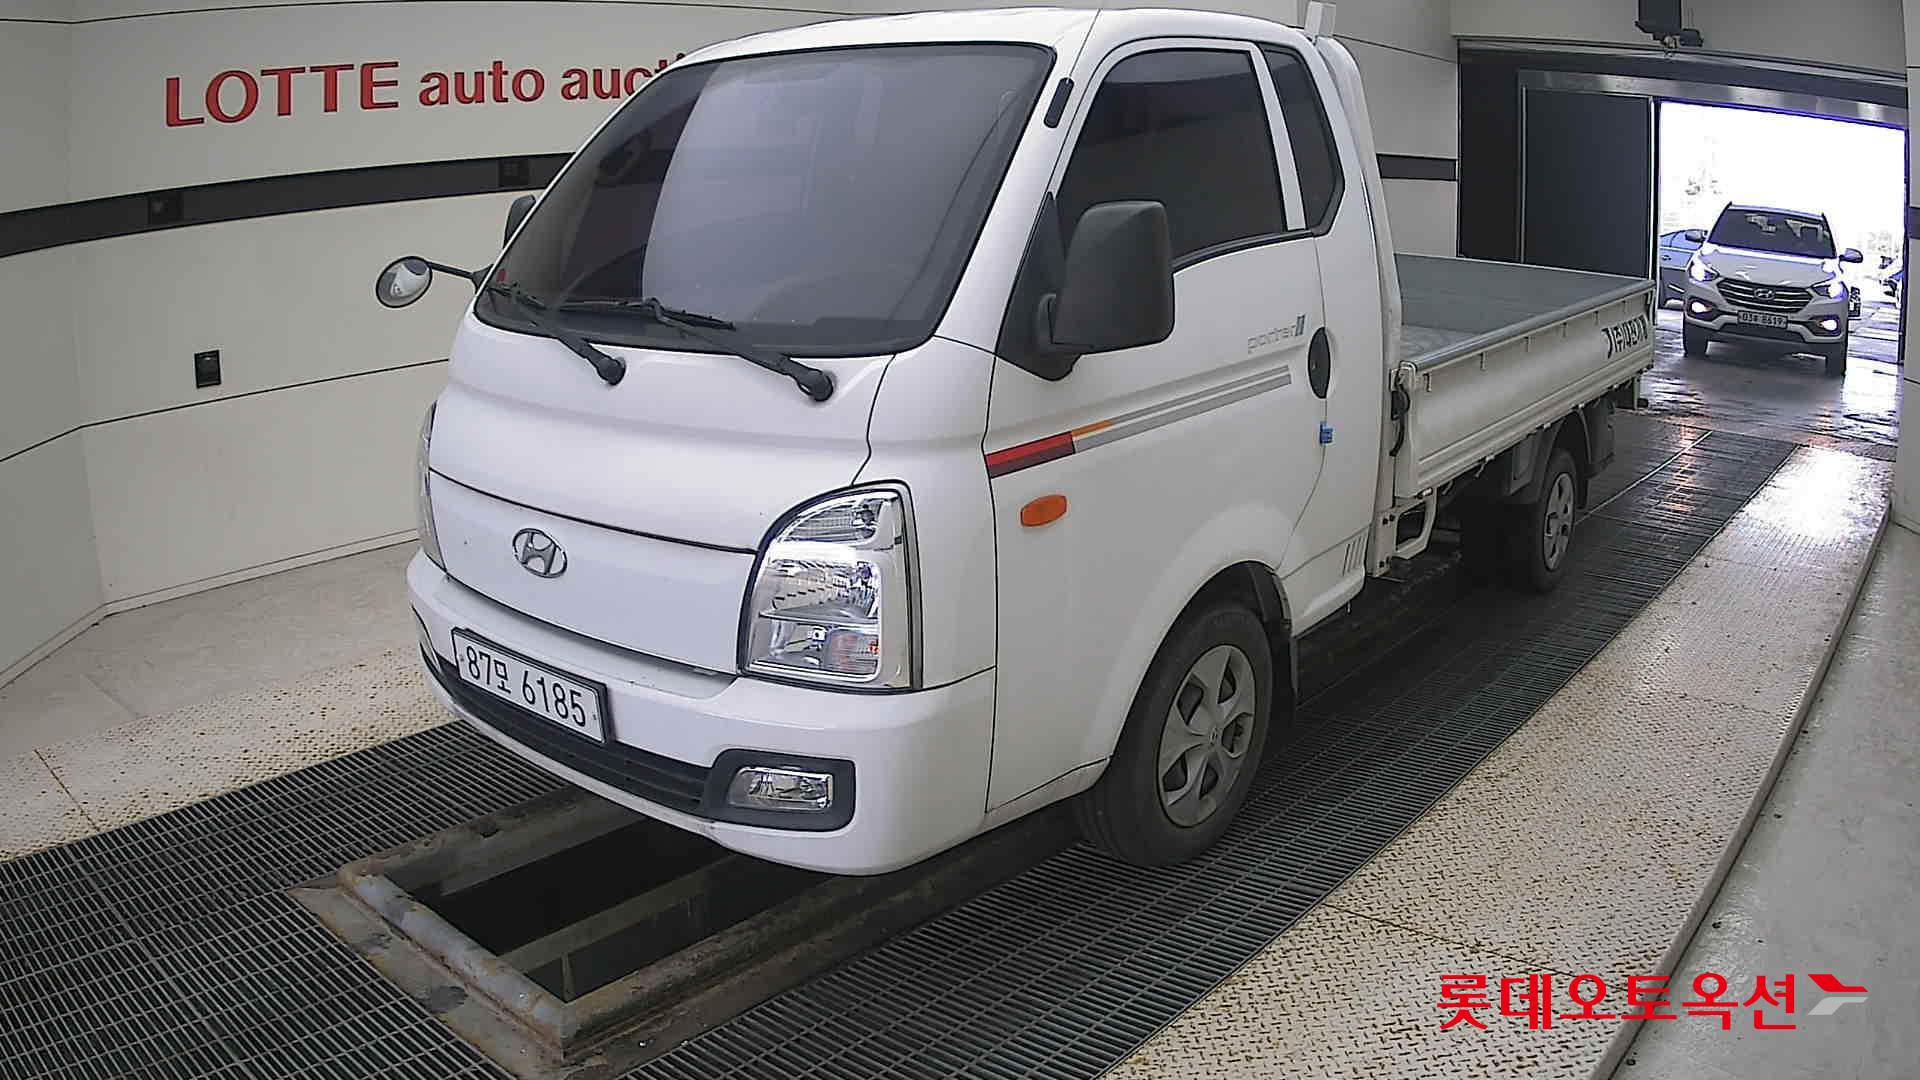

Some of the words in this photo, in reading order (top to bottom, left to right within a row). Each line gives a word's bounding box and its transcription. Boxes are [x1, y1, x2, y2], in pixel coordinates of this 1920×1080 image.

[165, 60, 400, 127] LOTTE
[418, 60, 545, 106] auto
[560, 52, 686, 100] auc
[466, 645, 512, 694] 87모
[521, 670, 586, 727] 6185
